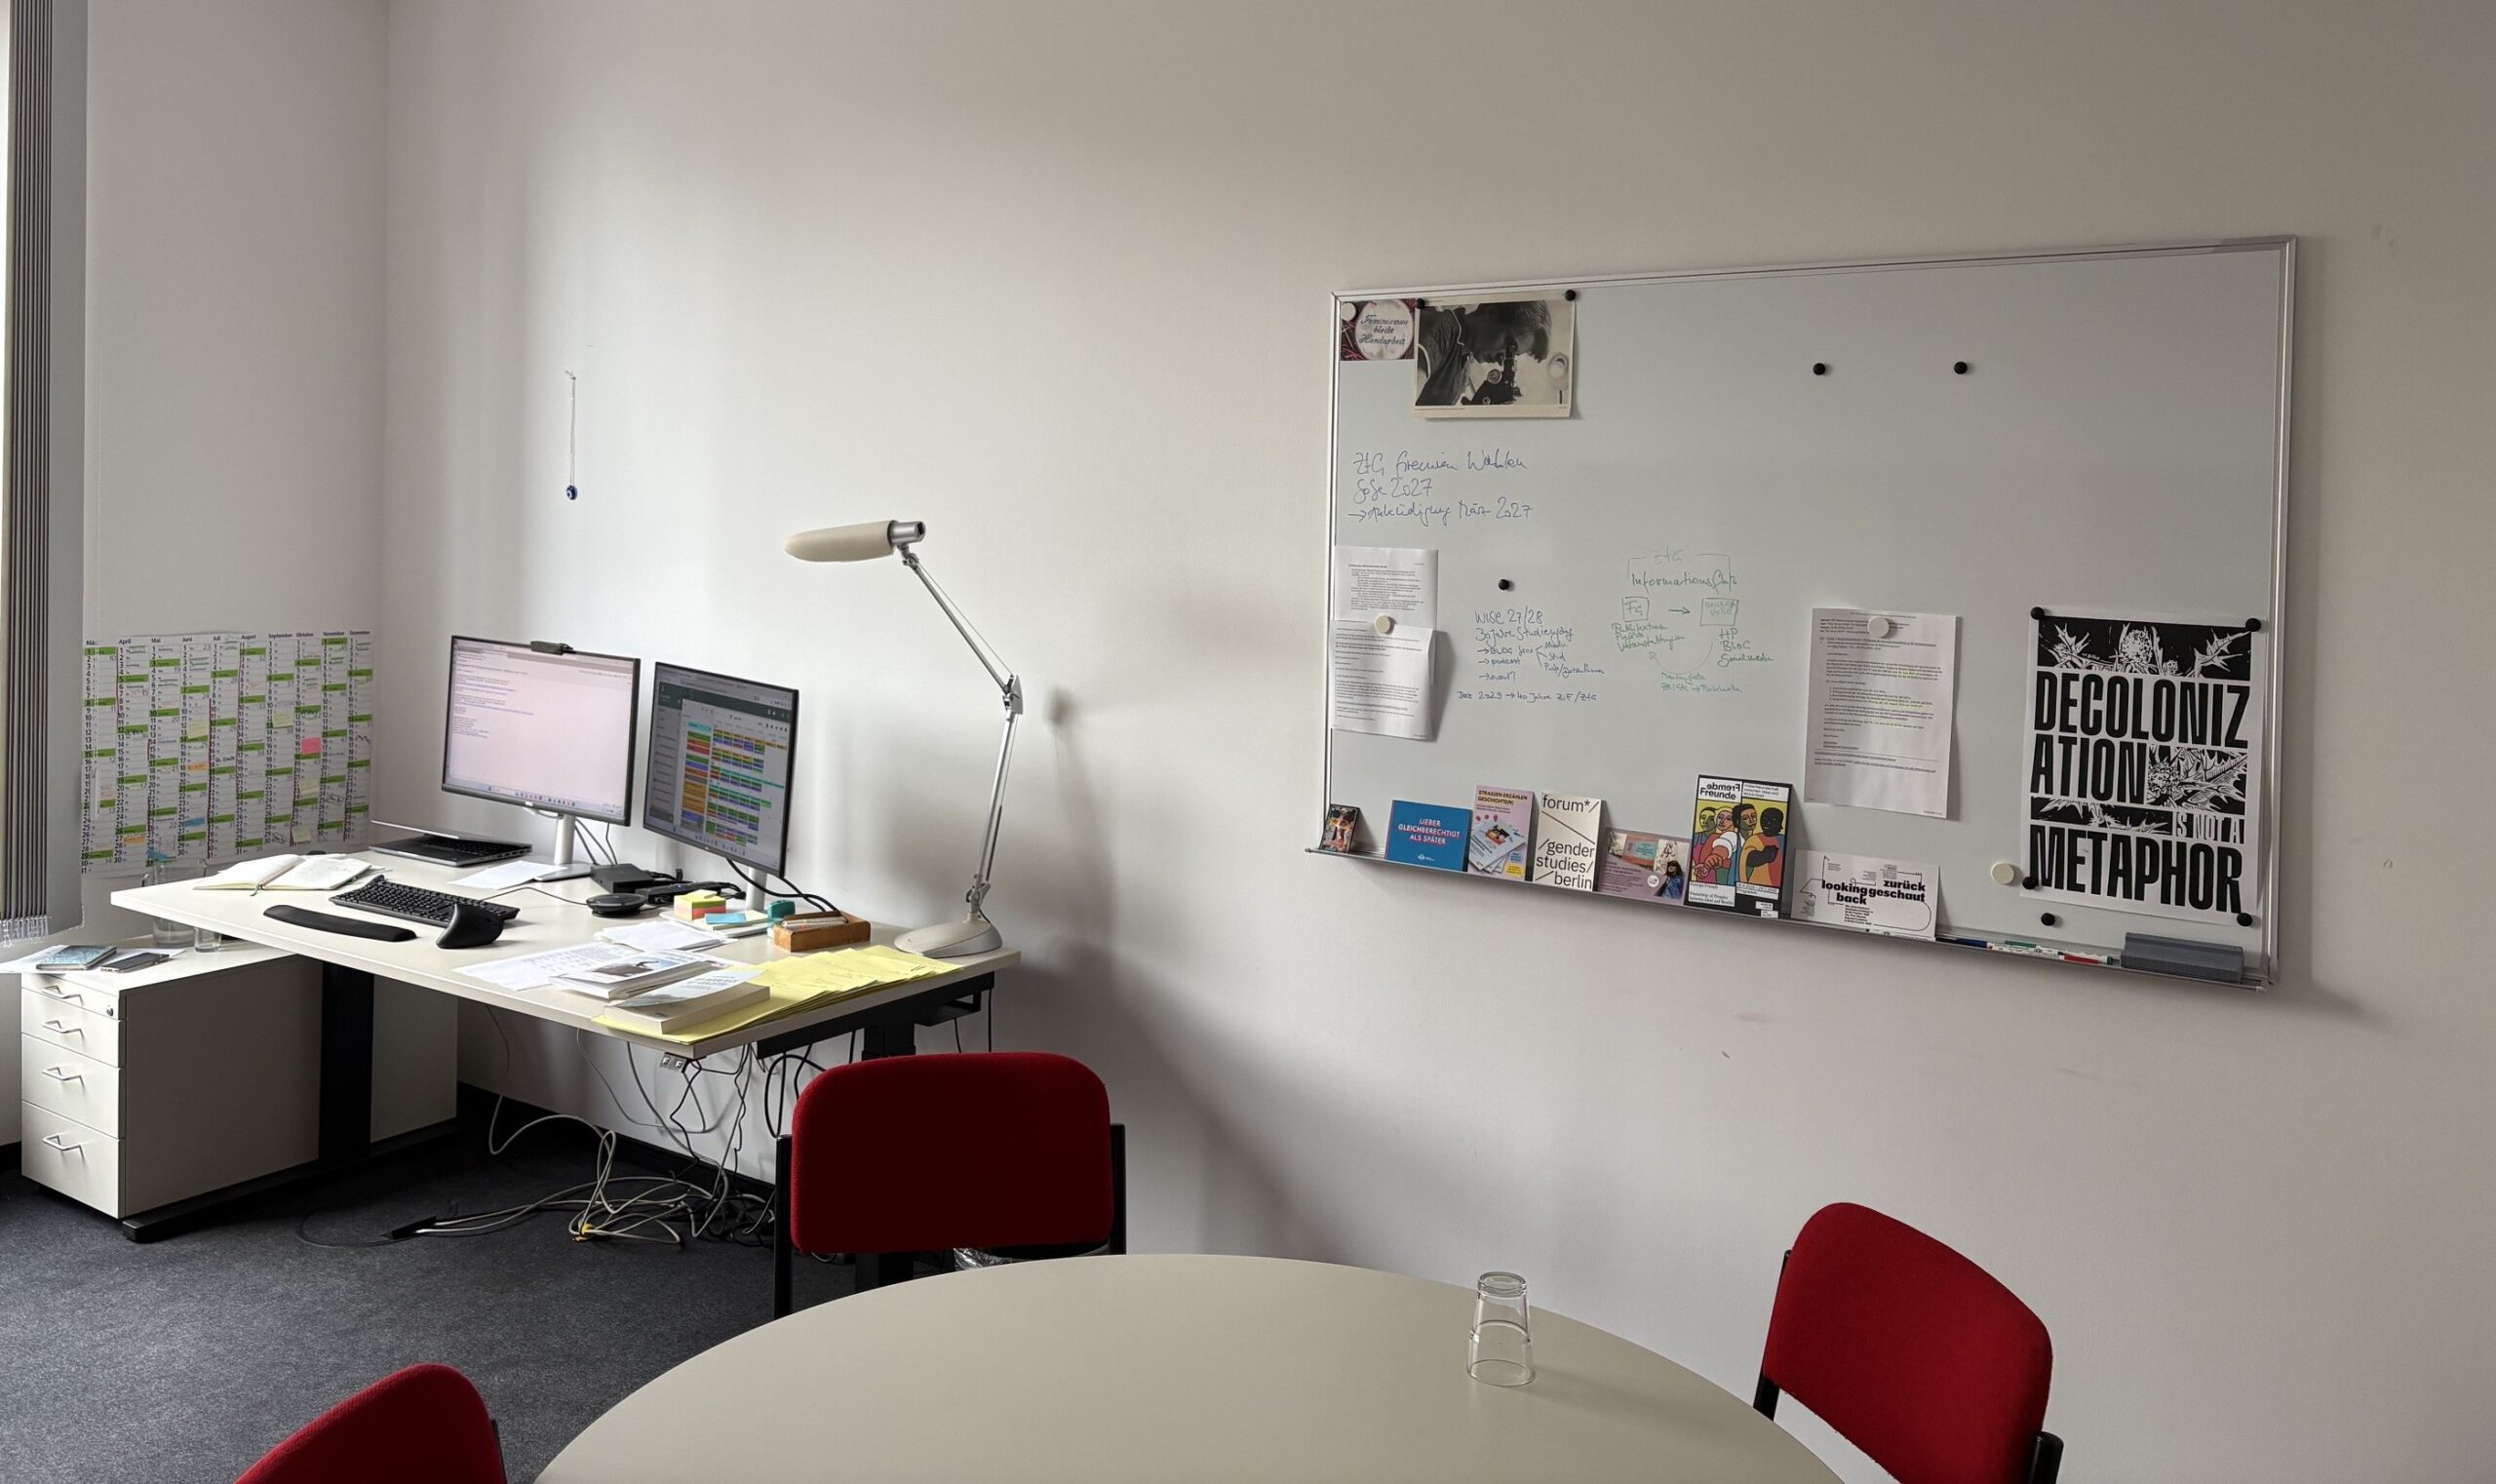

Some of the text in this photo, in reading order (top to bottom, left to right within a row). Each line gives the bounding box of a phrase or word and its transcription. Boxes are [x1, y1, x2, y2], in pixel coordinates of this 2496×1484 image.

[1359, 334, 1405, 345] Handarbeit
[1391, 478, 1433, 498] 2027
[1496, 496, 1534, 519] 2027
[1507, 605, 1543, 630] 27/28
[2034, 670, 2250, 748] DECOLONIZ
[2030, 734, 2146, 805] ATION
[1700, 788, 1736, 800] Freunde
[1398, 824, 1461, 838] GLEICHBERECHTIGT
[2194, 813, 2224, 841] NOT
[2230, 817, 2241, 844] A
[1424, 836, 1446, 845] SPÄTER
[2029, 825, 2242, 915] METAPHOR
[1822, 880, 1925, 902] looking geschaut
[1884, 880, 1926, 892] zurück
[1836, 892, 1867, 905] back
